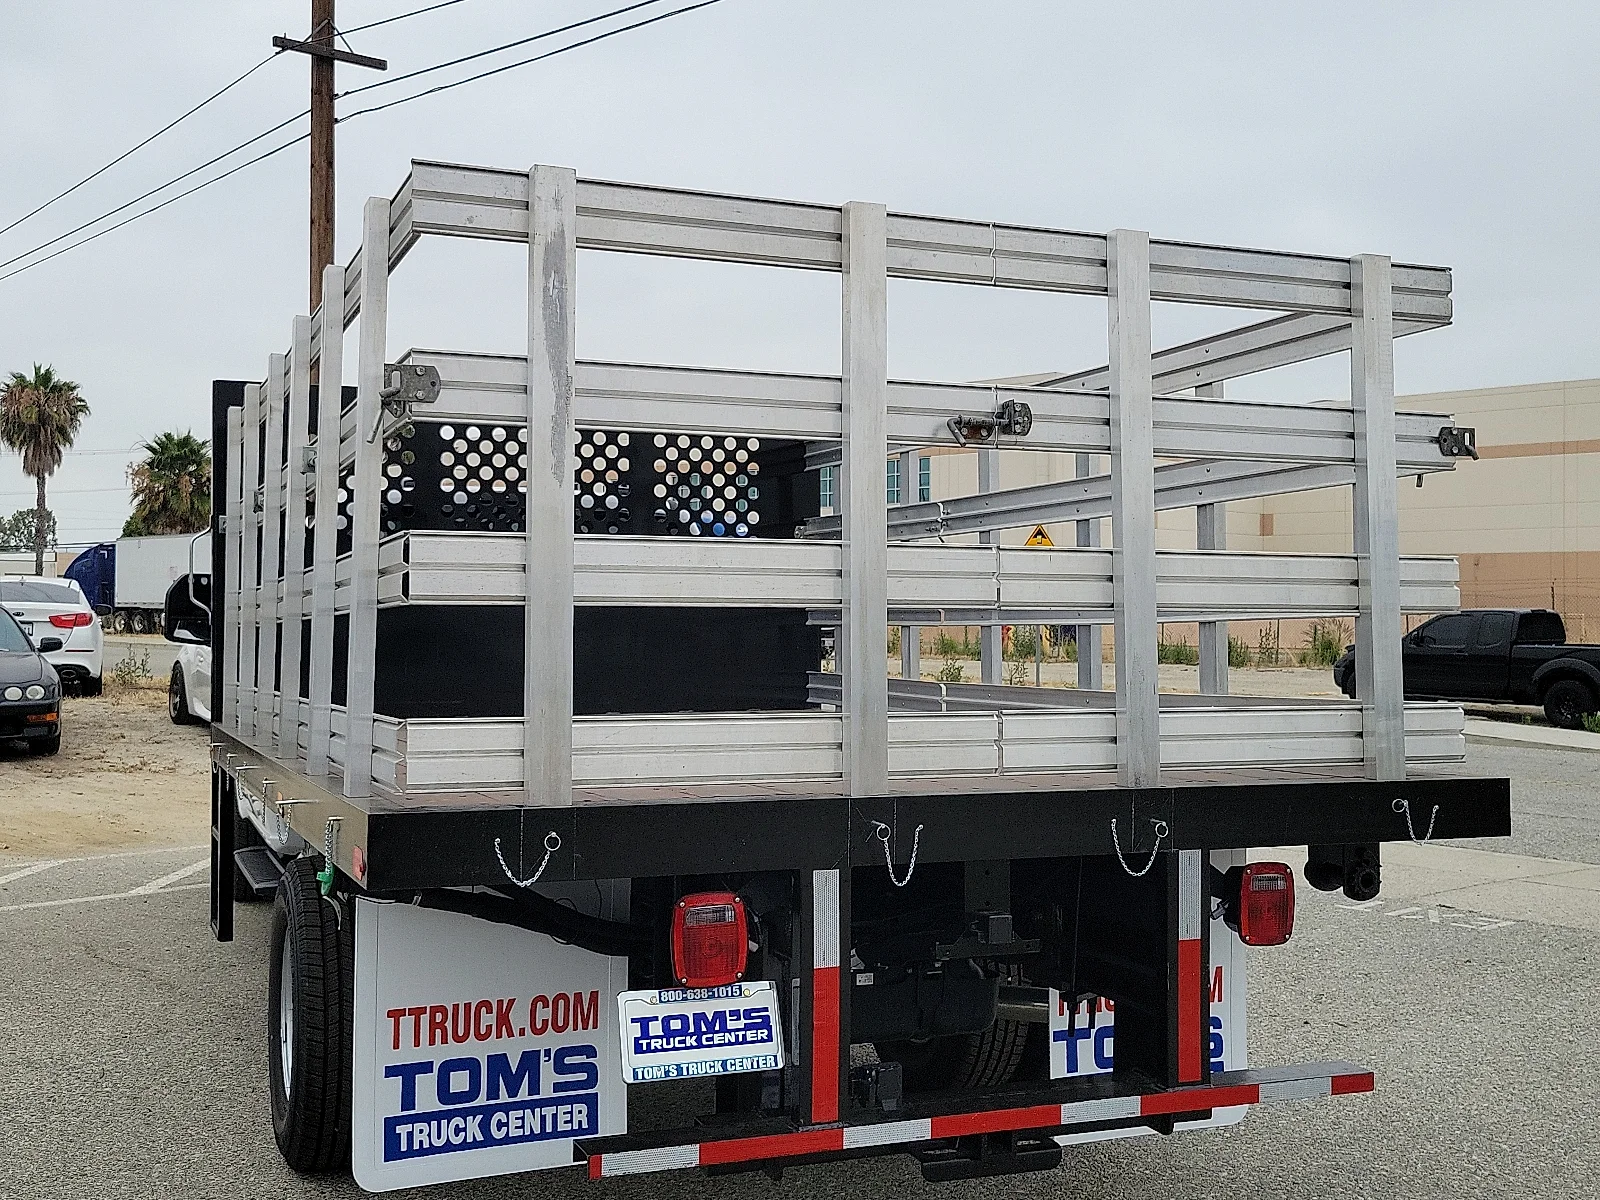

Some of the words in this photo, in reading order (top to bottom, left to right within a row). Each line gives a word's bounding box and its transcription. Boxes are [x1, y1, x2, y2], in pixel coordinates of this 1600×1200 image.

[661, 985, 740, 1001] 800-638-1015
[387, 989, 599, 1050] TTRUCK.COM
[631, 1007, 771, 1037] TOM'S
[639, 1034, 697, 1051] TRUCK
[702, 1029, 768, 1045] CENTER
[384, 1044, 599, 1112] TOM'S
[635, 1064, 677, 1080] TOM'S
[682, 1060, 724, 1076] TRUCK
[726, 1055, 775, 1071] CENTER
[396, 1114, 484, 1152] TRUCK
[490, 1104, 588, 1138] CENTER
